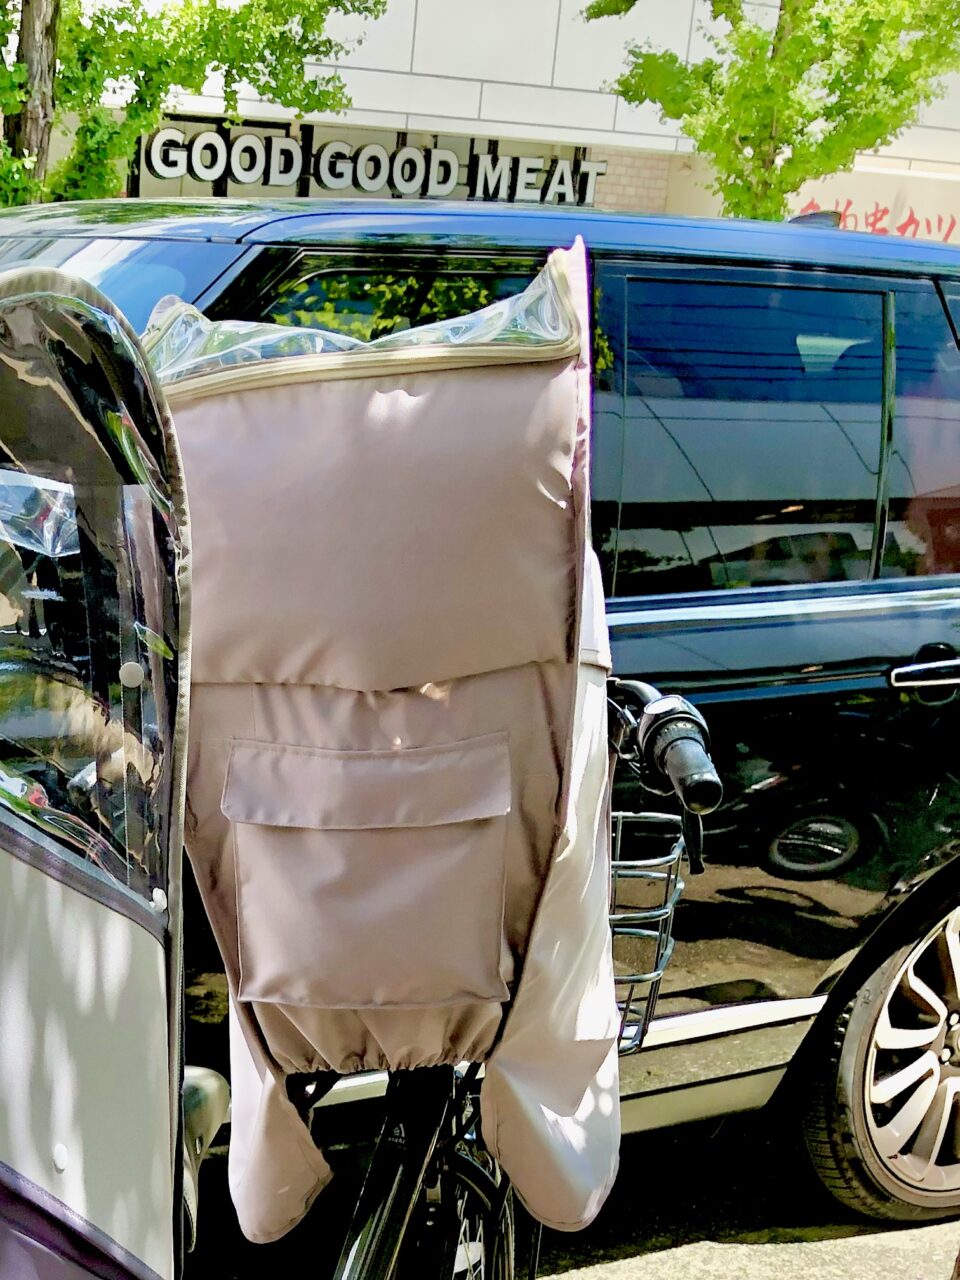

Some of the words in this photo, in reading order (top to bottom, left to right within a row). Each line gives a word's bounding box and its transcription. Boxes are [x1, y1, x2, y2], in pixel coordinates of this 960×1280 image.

[148, 126, 305, 187] GOOD
[316, 141, 459, 197] GOOD
[475, 153, 608, 206] MEAT
